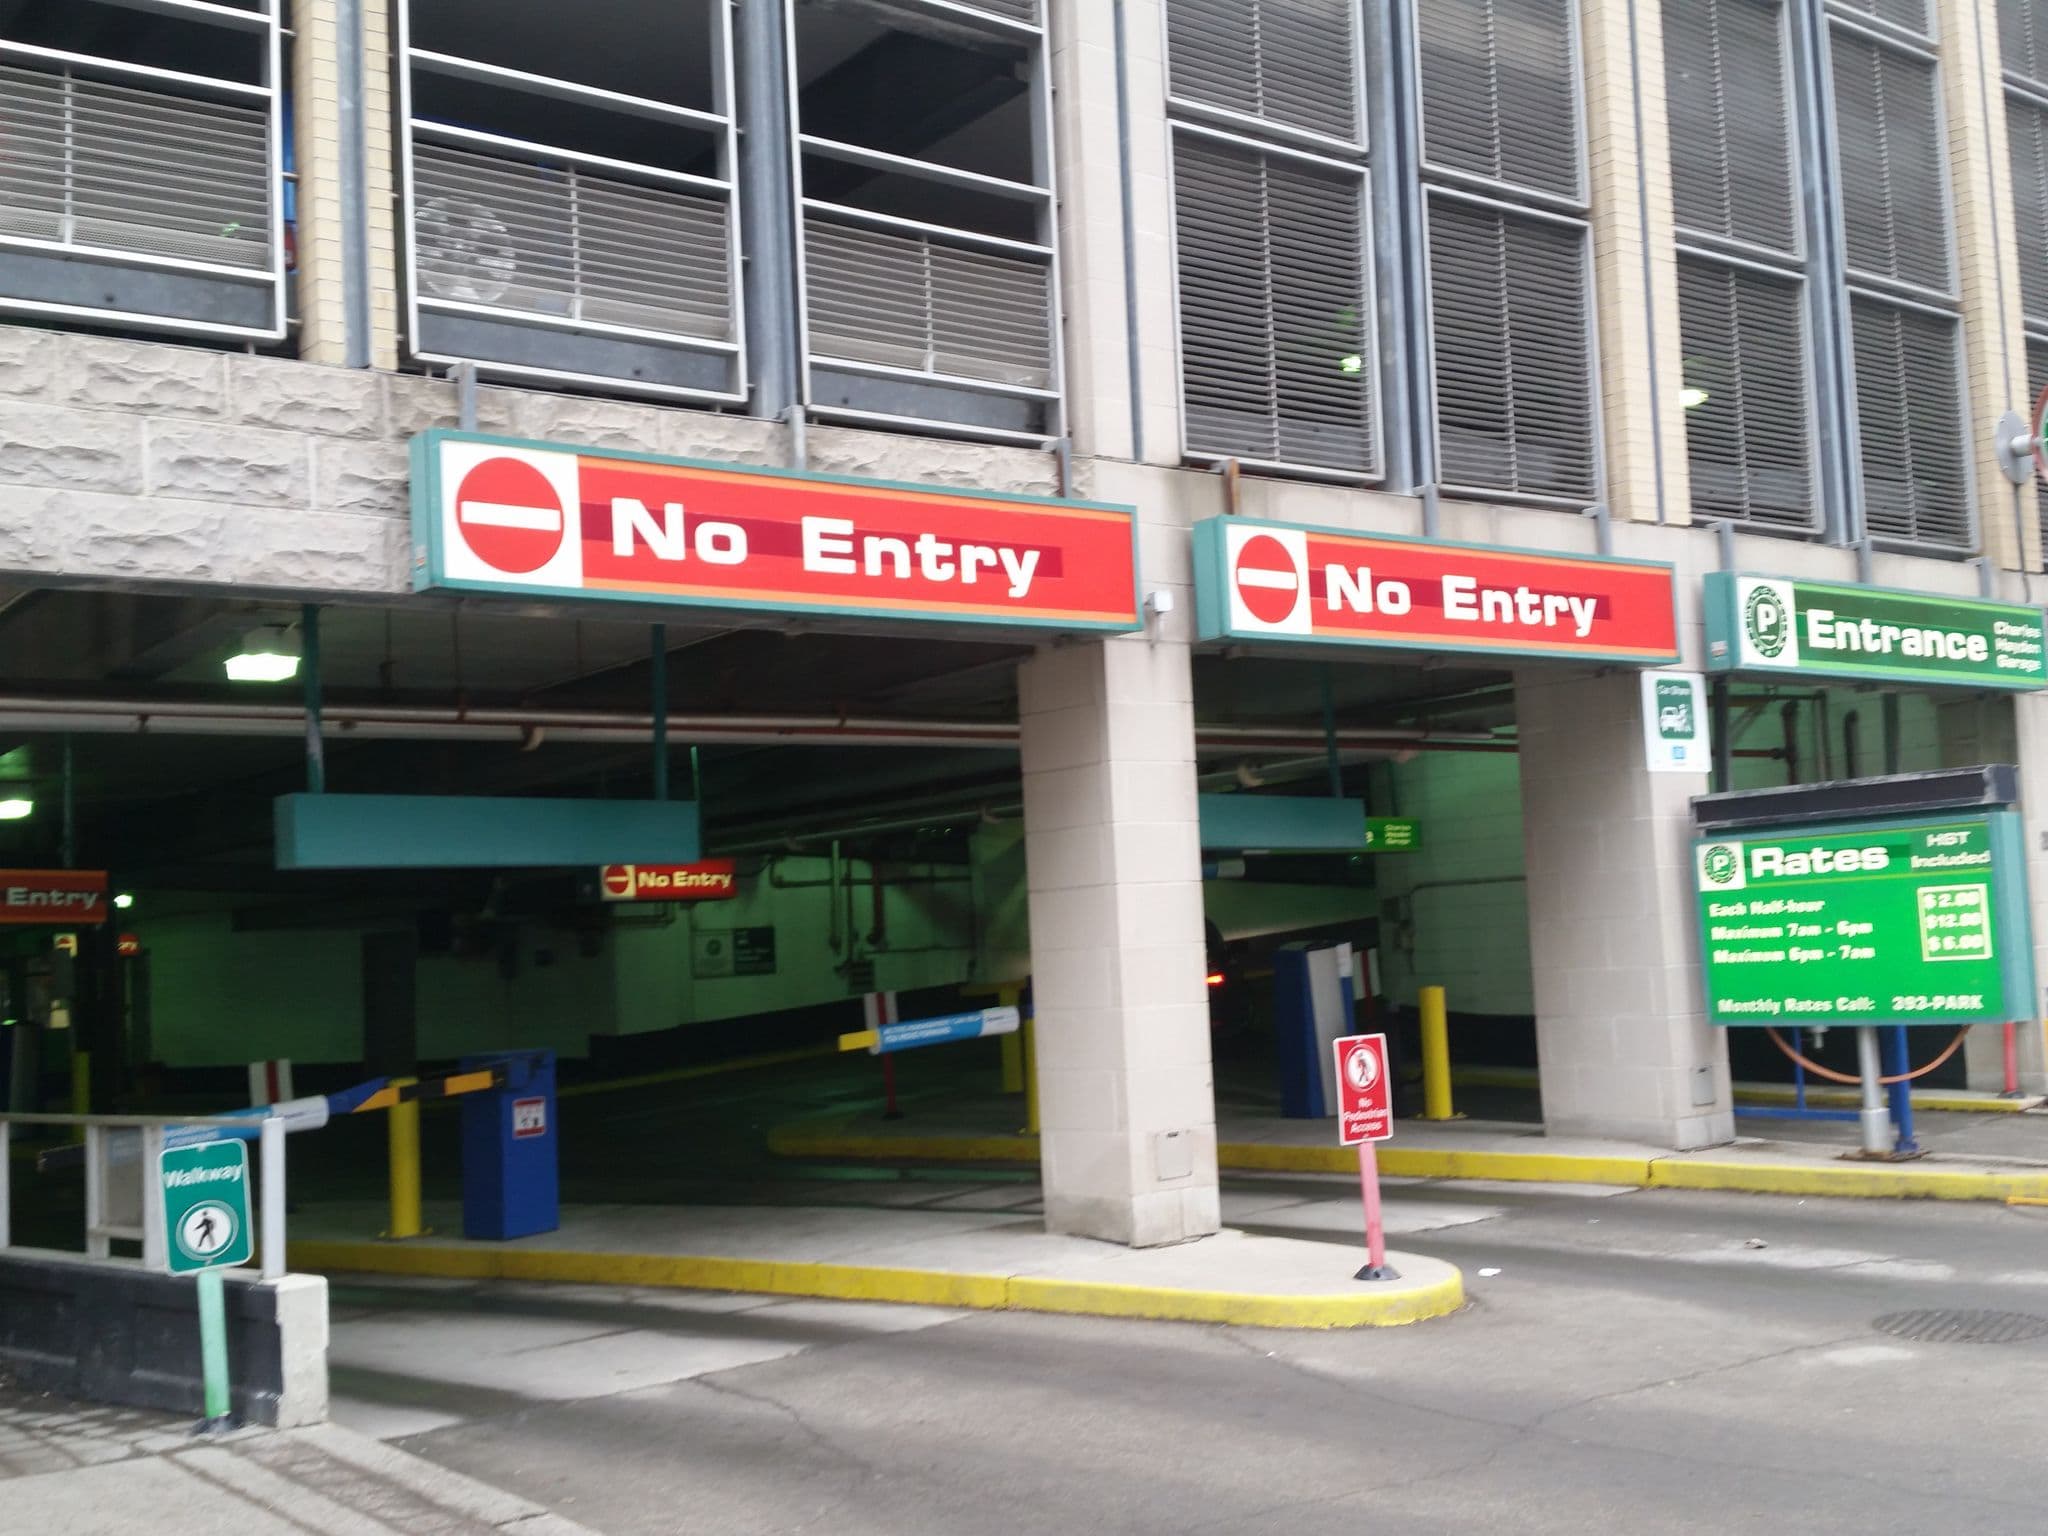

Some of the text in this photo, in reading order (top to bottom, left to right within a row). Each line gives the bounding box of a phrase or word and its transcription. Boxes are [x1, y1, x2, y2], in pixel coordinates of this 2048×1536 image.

[611, 498, 1041, 598] No Entry
[1325, 563, 1597, 637] No Entry
[1806, 608, 1988, 662] Entrance
[1926, 831, 1971, 848] HST
[1751, 846, 1890, 879] Rates
[1911, 850, 1991, 869] Included
[638, 870, 733, 889] No Entry
[6, 886, 98, 911] Entry
[1709, 899, 1826, 917] Each Half-hour
[1711, 925, 1784, 940] Maximum
[1786, 922, 1822, 937] 7am
[1713, 949, 1786, 964] Maximum
[1838, 944, 1876, 960] 7am
[1717, 998, 1781, 1014] Monthly
[1784, 998, 1833, 1012] Rates
[1343, 1108, 1388, 1121] Pedestrian
[1350, 1120, 1383, 1134] Access
[163, 1163, 244, 1189] Walkway
